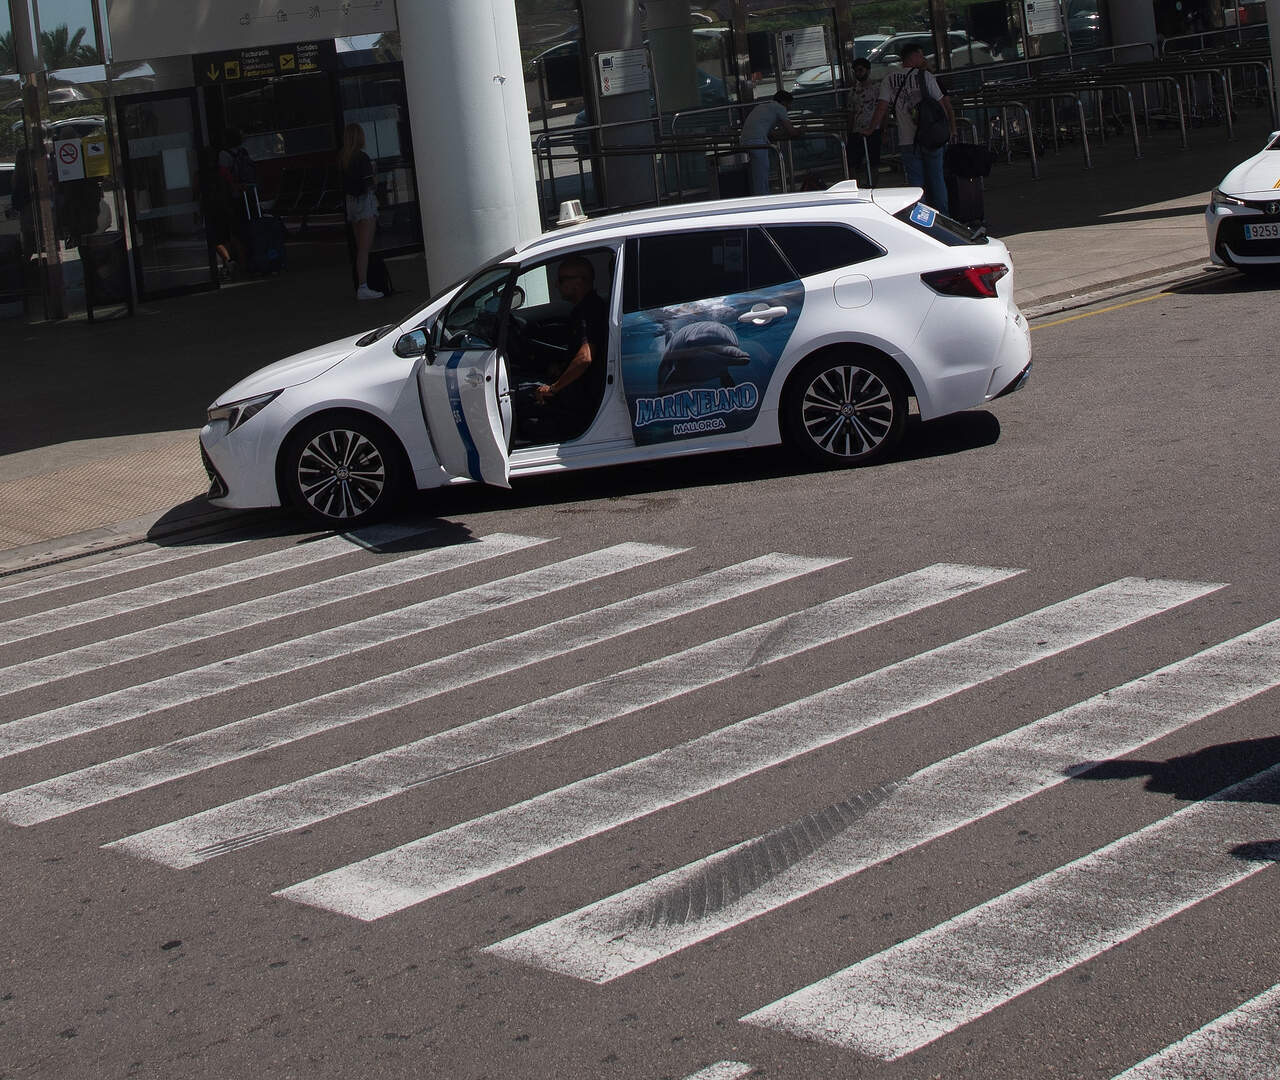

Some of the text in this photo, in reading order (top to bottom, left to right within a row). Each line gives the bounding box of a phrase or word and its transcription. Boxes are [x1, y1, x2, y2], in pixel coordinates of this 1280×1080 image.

[1251, 224, 1279, 238] 9259
[635, 382, 759, 427] MARINELAND
[673, 418, 726, 435] MALLORCA
